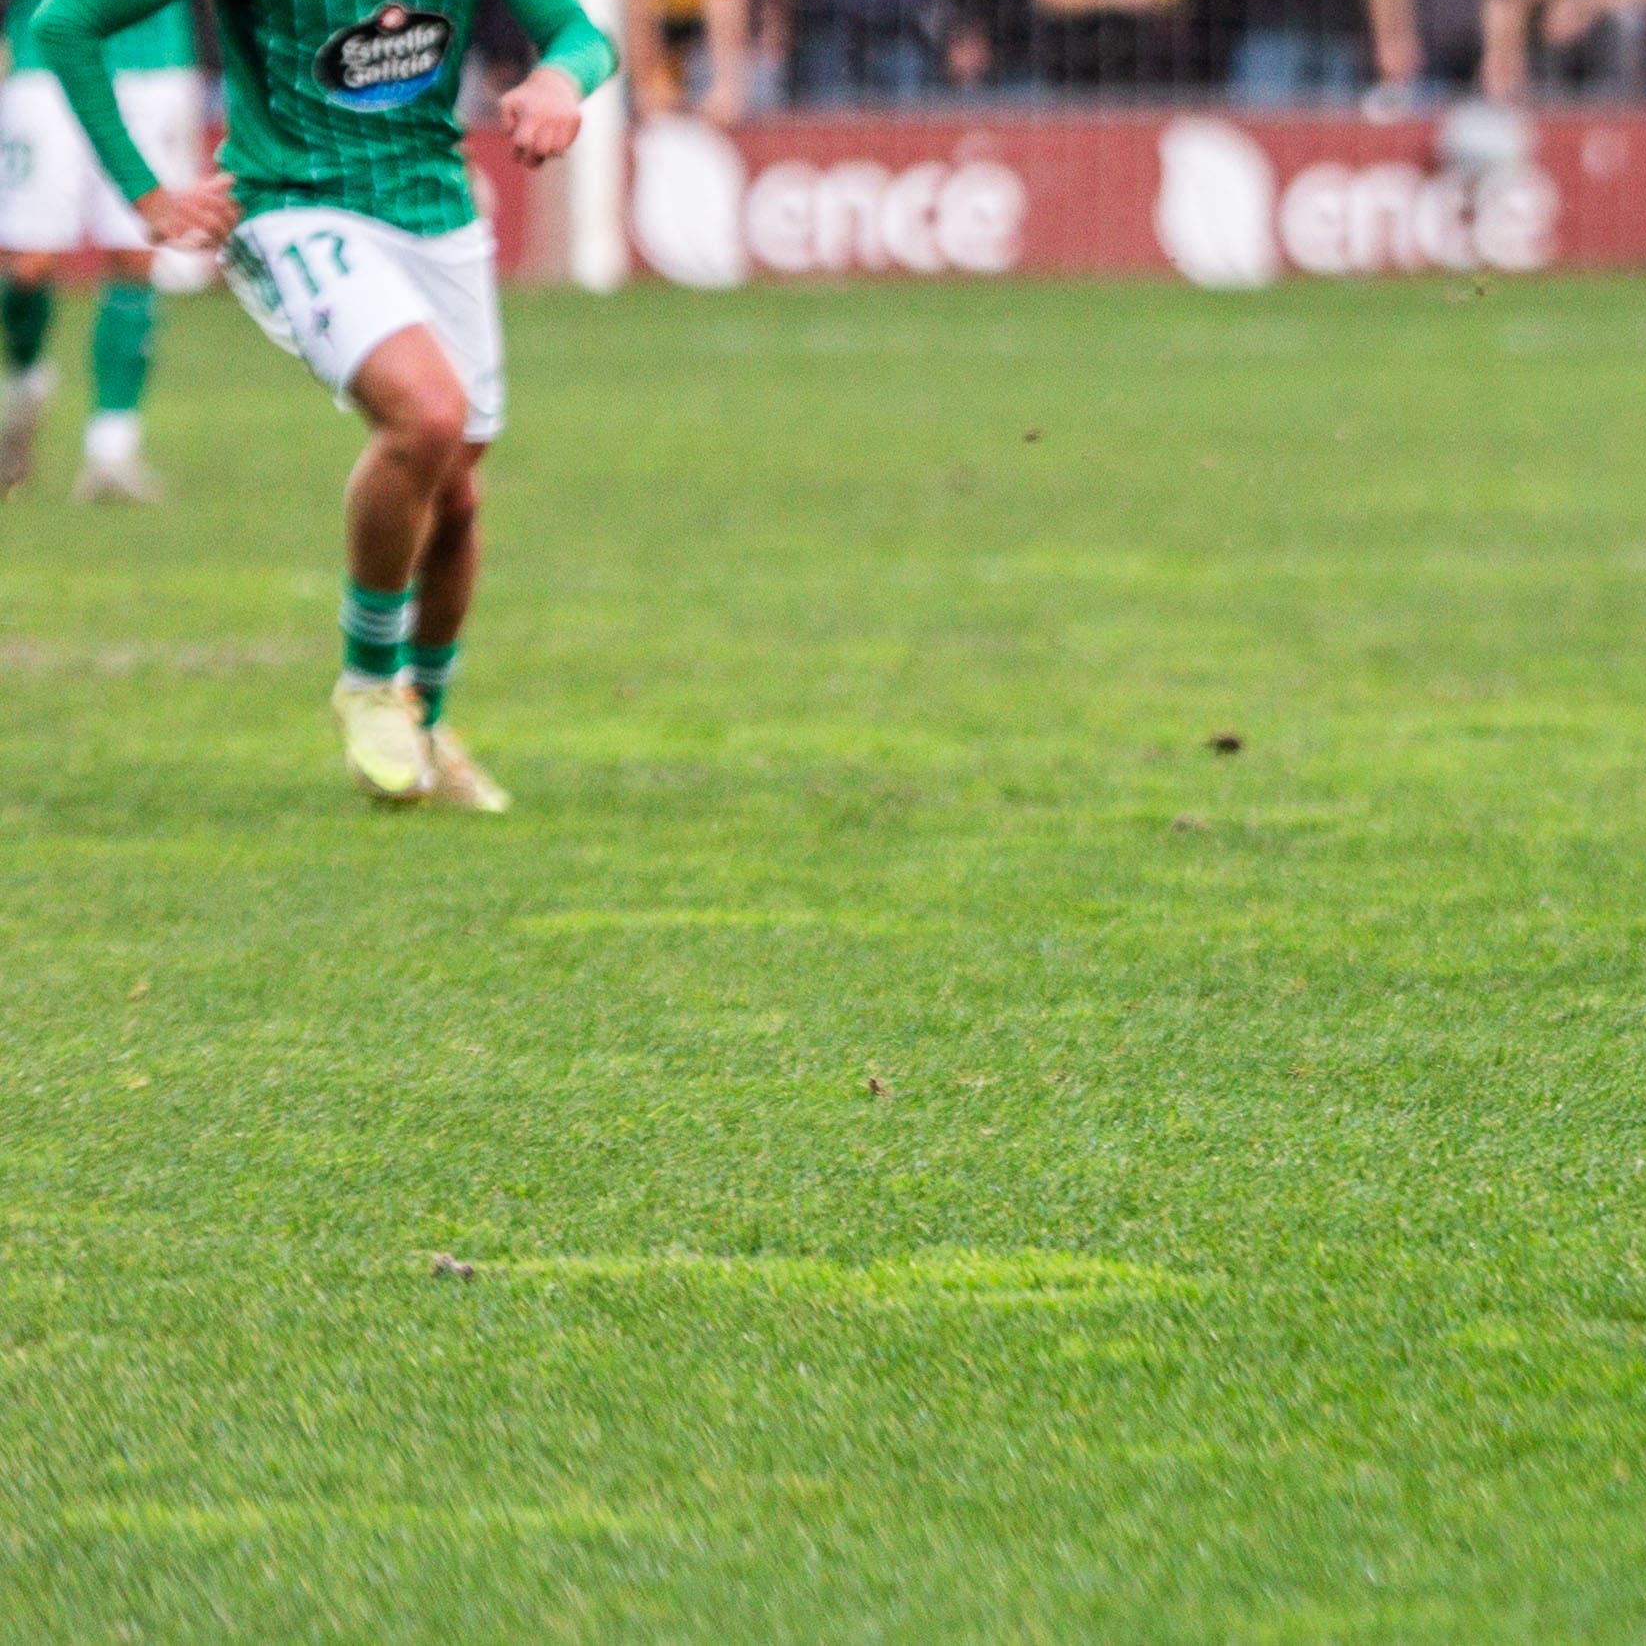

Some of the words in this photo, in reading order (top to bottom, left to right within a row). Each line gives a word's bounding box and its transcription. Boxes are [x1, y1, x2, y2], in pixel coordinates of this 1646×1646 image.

[281, 230, 351, 296] 17
[747, 157, 1027, 273] ence
[1277, 162, 1559, 272] ence
